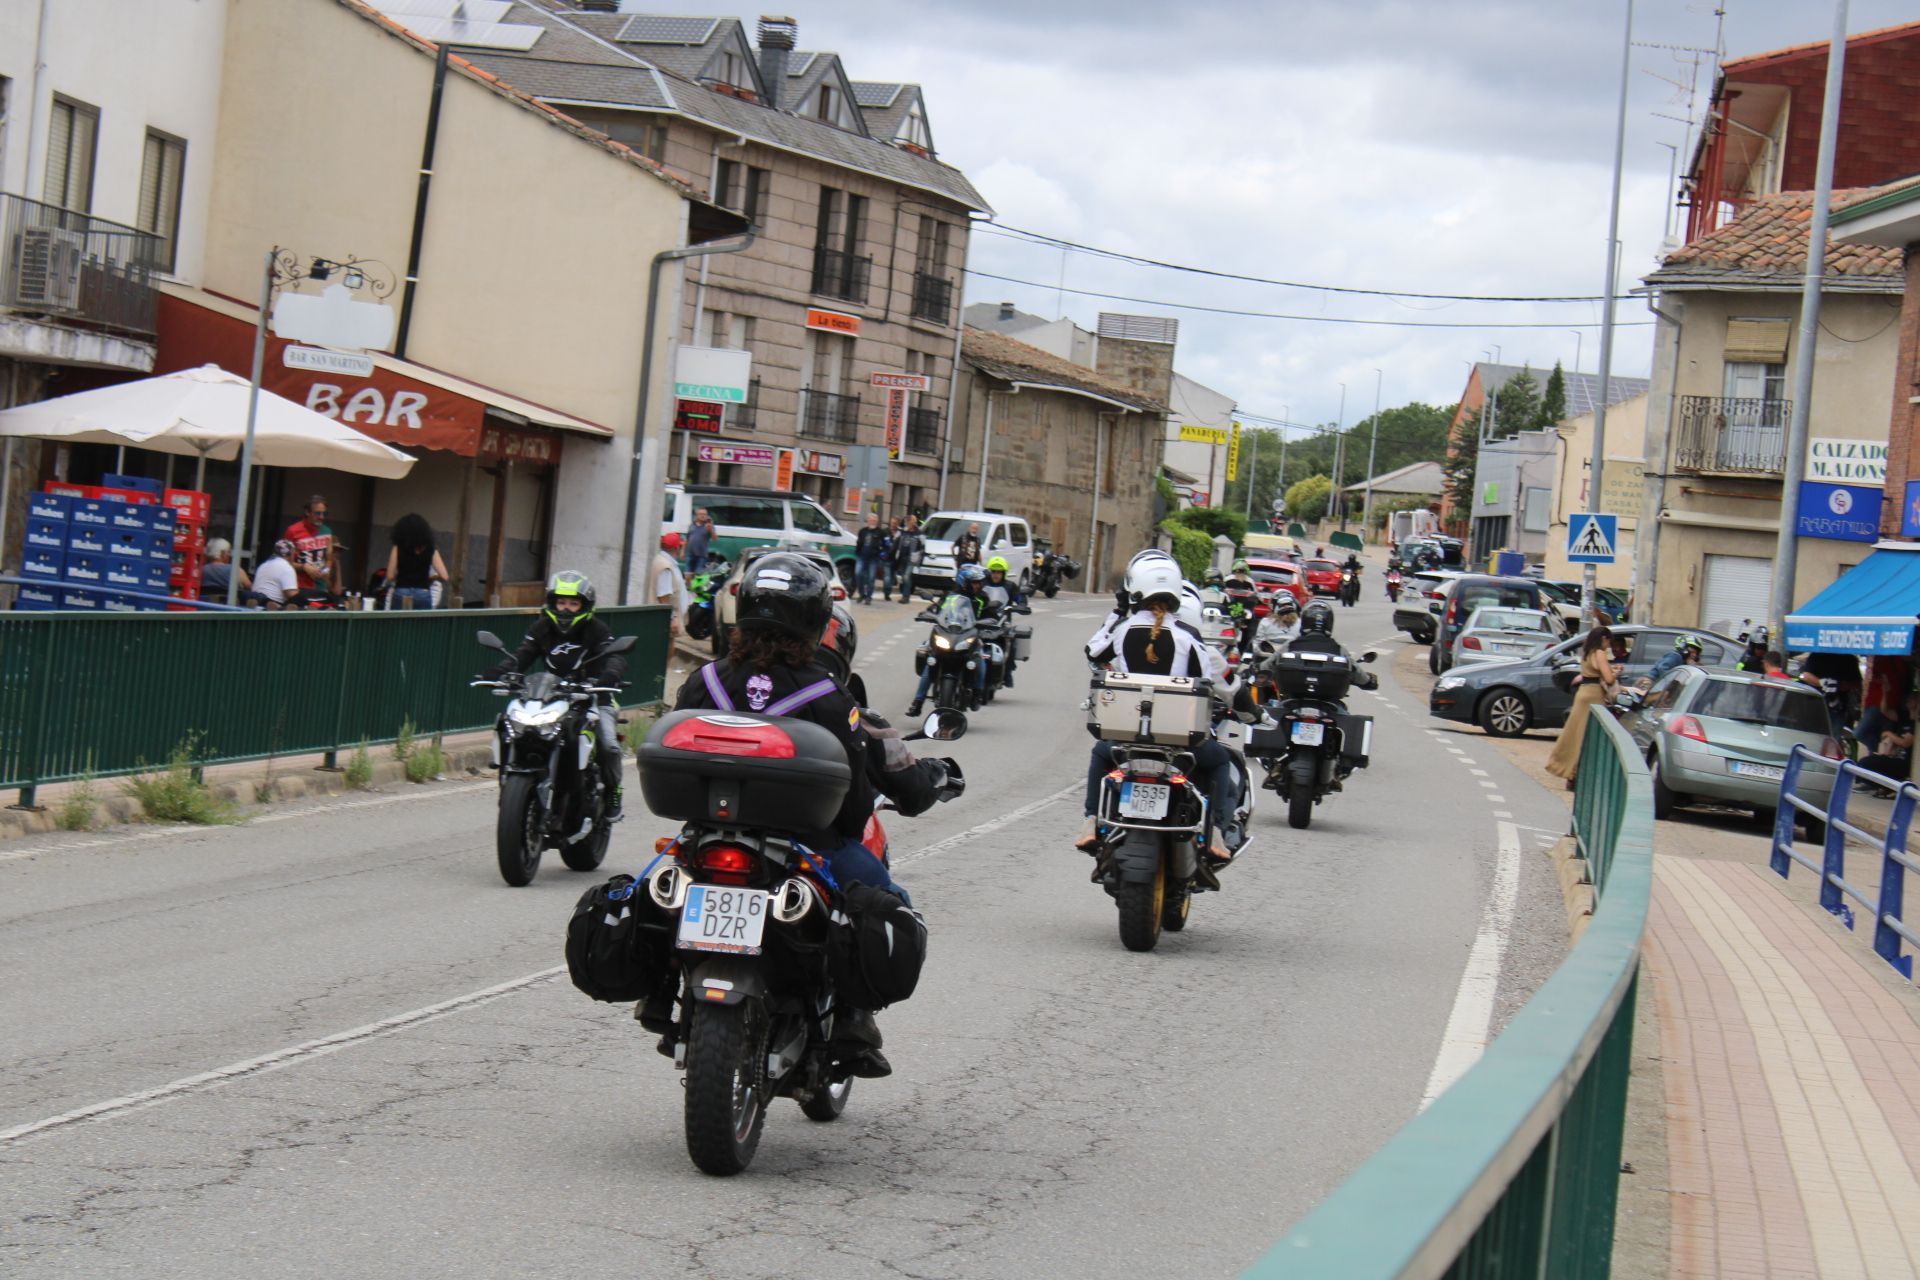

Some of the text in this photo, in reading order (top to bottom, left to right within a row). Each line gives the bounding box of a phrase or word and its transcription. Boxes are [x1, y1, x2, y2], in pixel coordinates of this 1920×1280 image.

[289, 351, 369, 371] BAR SAN MARTINO
[874, 376, 922, 387] PRENSA
[677, 384, 733, 400] CECINA
[305, 383, 429, 429] BAR
[676, 417, 720, 433] LOMO
[1132, 785, 1168, 800] 5535
[704, 890, 762, 916] 5816
[703, 914, 747, 940] DZR
